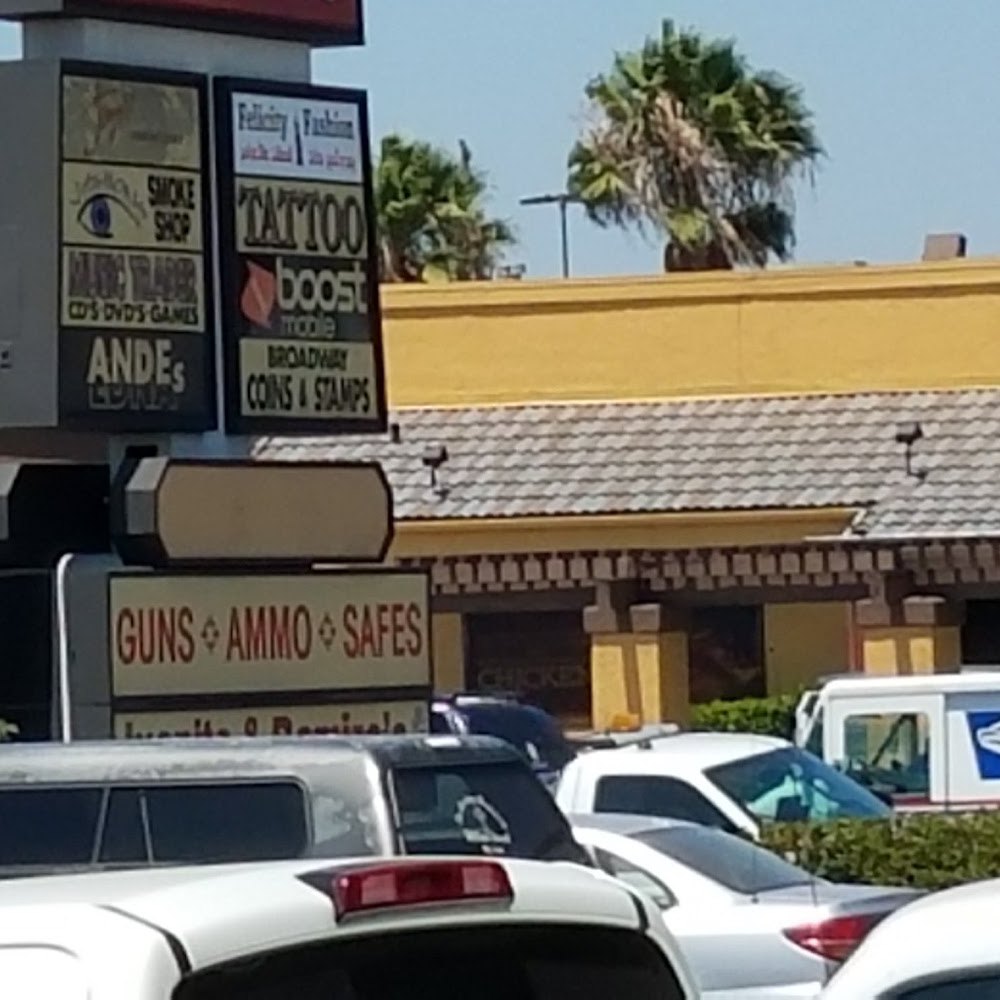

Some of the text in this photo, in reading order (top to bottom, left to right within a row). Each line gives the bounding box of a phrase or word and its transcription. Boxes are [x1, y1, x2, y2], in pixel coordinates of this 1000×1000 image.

[154, 211, 191, 244] SHOP
[238, 185, 365, 255] TATTOO
[276, 256, 368, 315] boost
[268, 345, 348, 371] BROADWAY
[247, 373, 293, 410] COINS
[314, 377, 371, 413] STAMPS
[117, 602, 422, 665] GUNS AMMO SAFES
